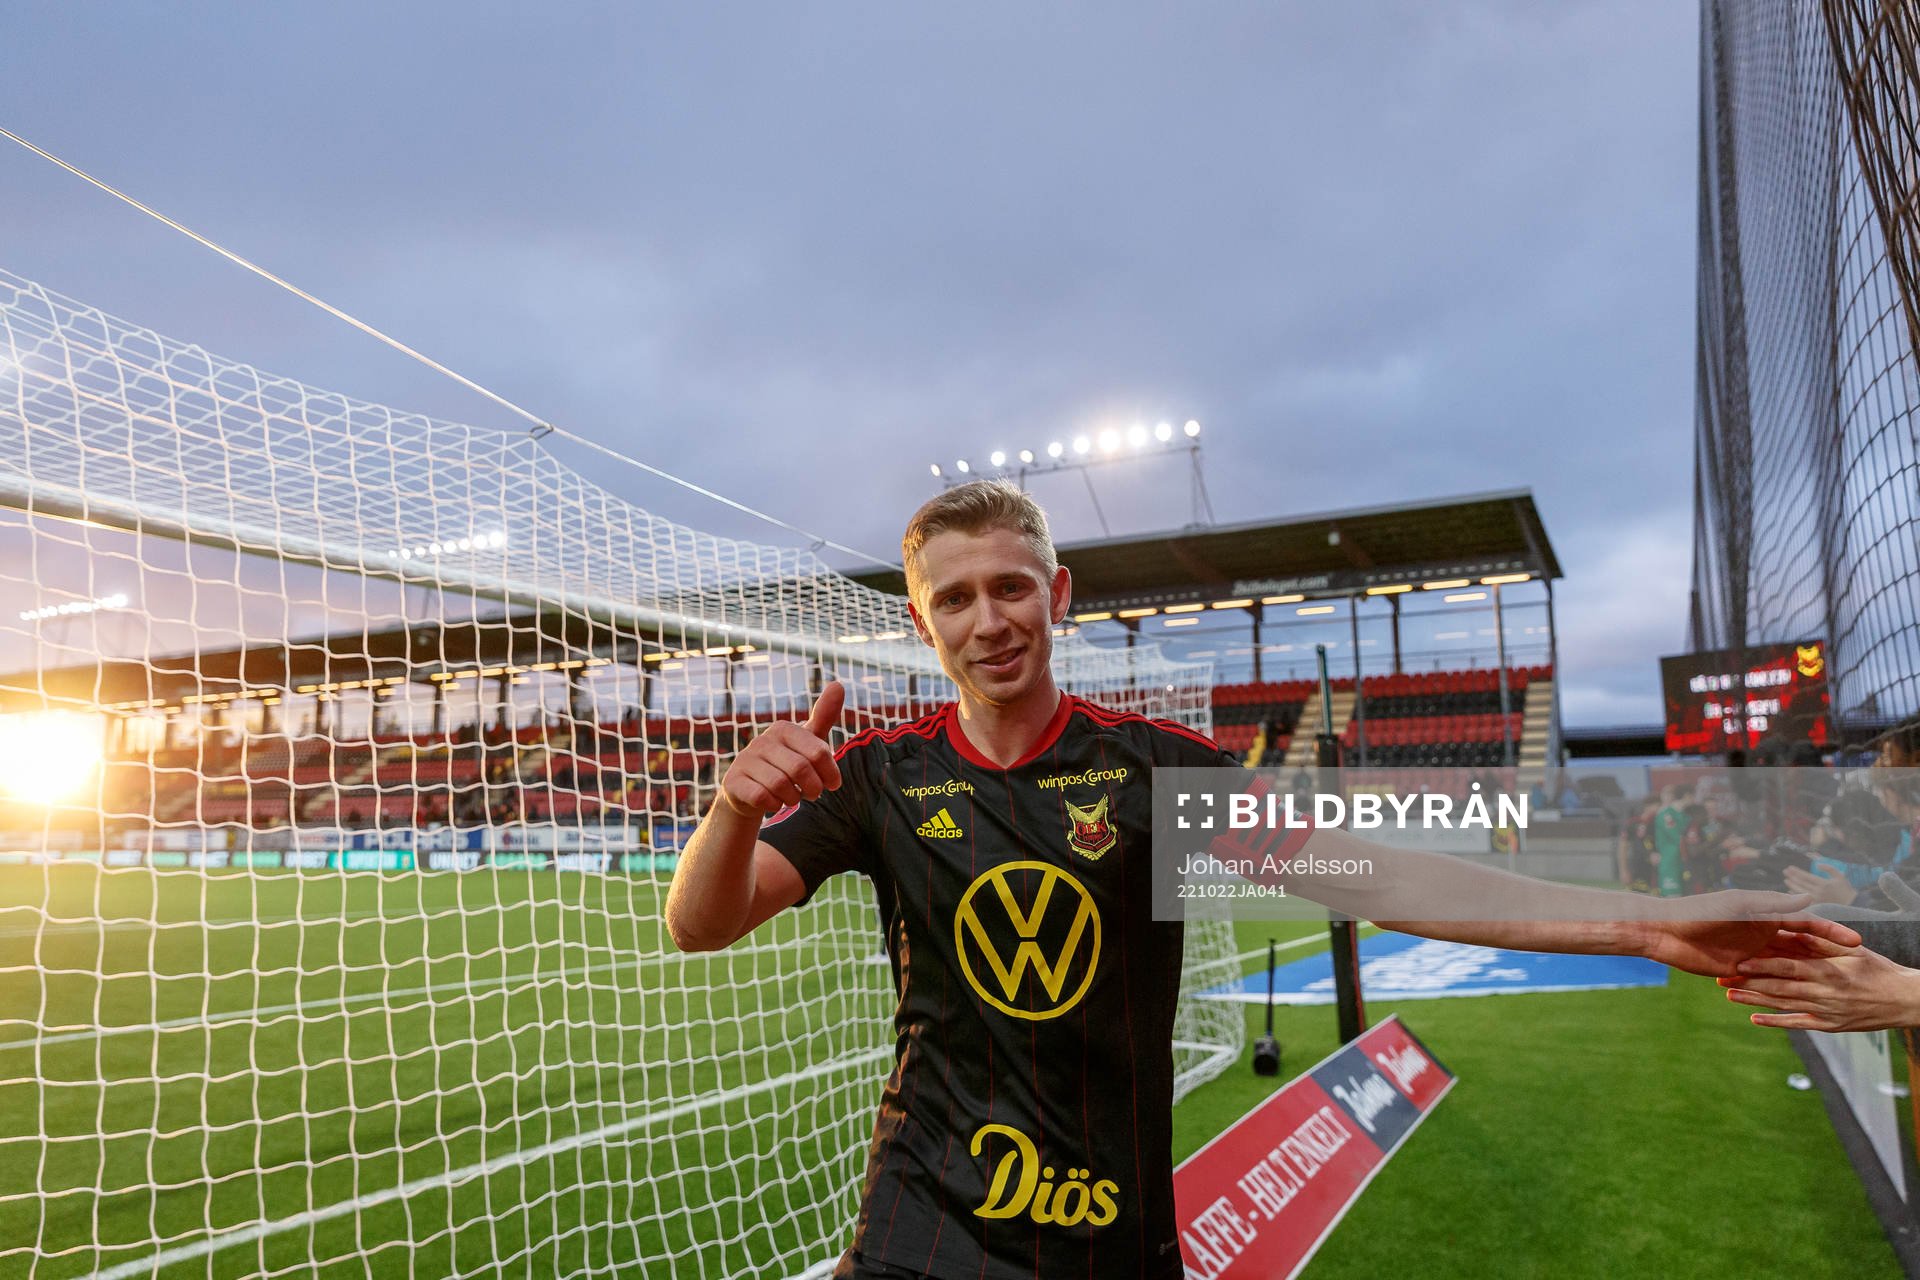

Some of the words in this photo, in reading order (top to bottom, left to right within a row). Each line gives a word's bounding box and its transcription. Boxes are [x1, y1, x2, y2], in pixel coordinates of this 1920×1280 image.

[916, 827, 964, 839] adidas
[971, 1123, 1120, 1226] Diös
[1237, 1148, 1306, 1220] HELT
